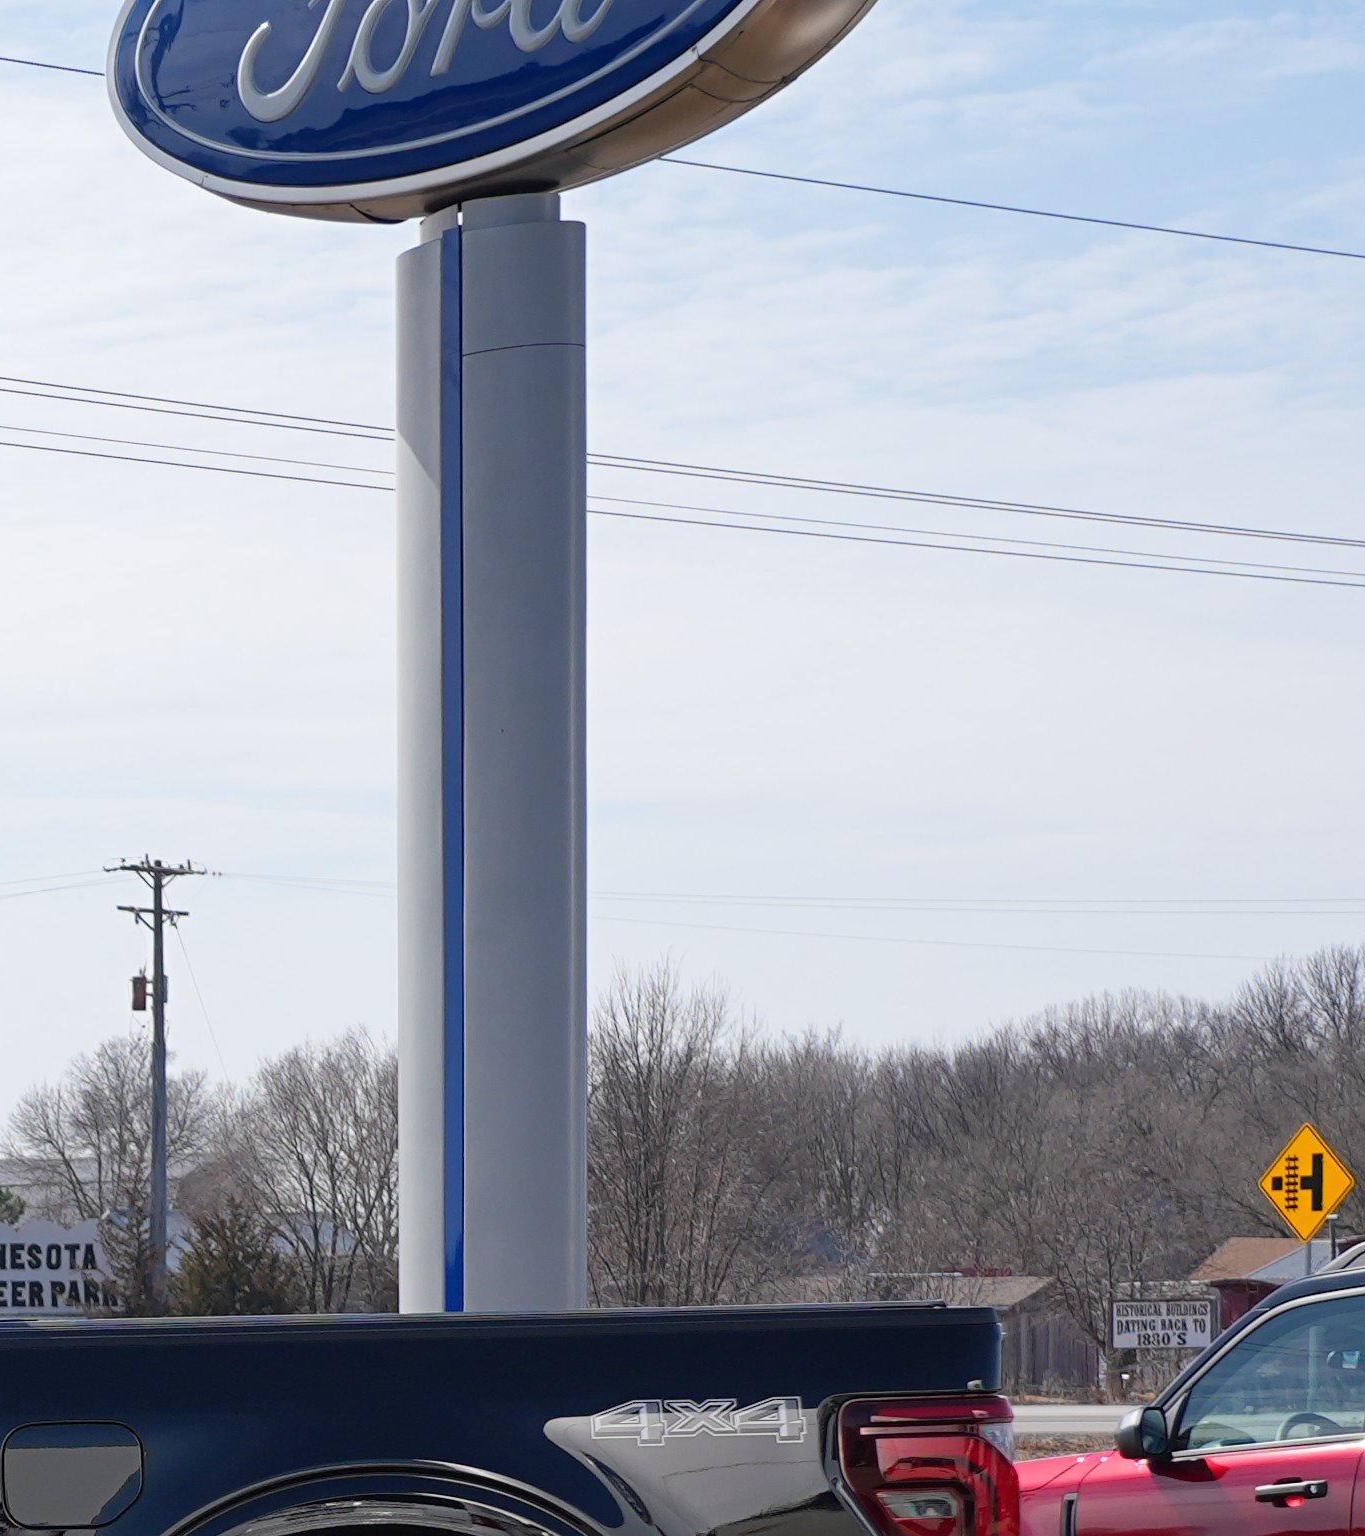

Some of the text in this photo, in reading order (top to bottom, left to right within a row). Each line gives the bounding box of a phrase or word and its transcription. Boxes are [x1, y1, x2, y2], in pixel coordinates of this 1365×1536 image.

[1116, 1303, 1208, 1317] HISTORICAL BUILDINGS
[1117, 1318, 1206, 1335] DATING BACK TO
